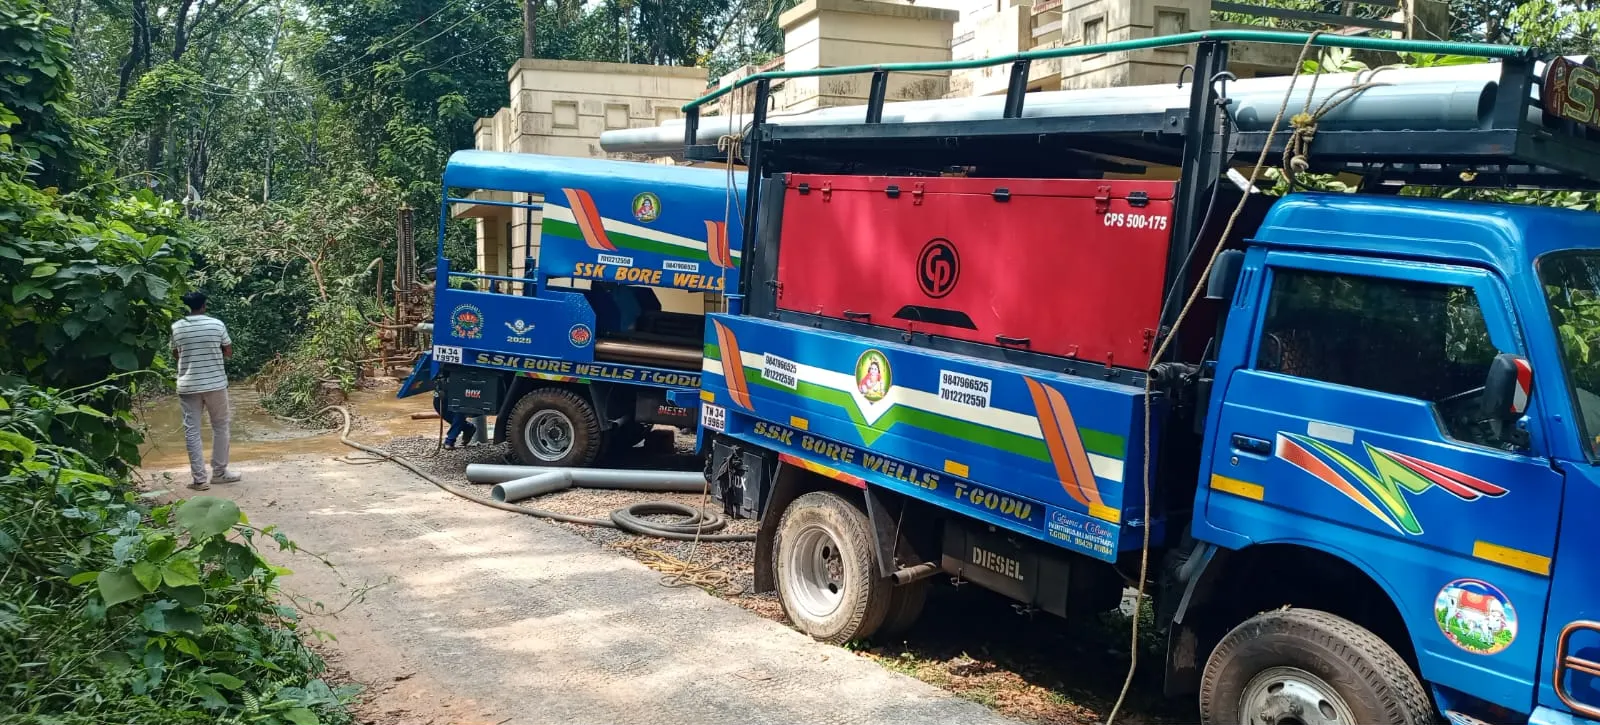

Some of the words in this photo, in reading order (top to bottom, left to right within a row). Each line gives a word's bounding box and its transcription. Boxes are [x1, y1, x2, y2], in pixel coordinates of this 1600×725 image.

[1104, 212, 1124, 228] CPS
[1126, 213, 1168, 231] 500-175
[573, 262, 606, 278] SSK
[614, 266, 662, 284] BORE
[673, 273, 726, 291] WELLS
[523, 358, 573, 373] BORE
[575, 364, 635, 381] WELLS
[765, 355, 797, 374] 9847966525
[763, 367, 795, 387] 7012212550
[943, 373, 989, 393] 9847966525
[941, 388, 987, 408] 7012212550
[657, 405, 688, 417] DIESEL
[715, 408, 724, 418] 34
[801, 435, 856, 463] BORE
[863, 453, 939, 490] WELLS
[972, 546, 1024, 581] DIESEL
